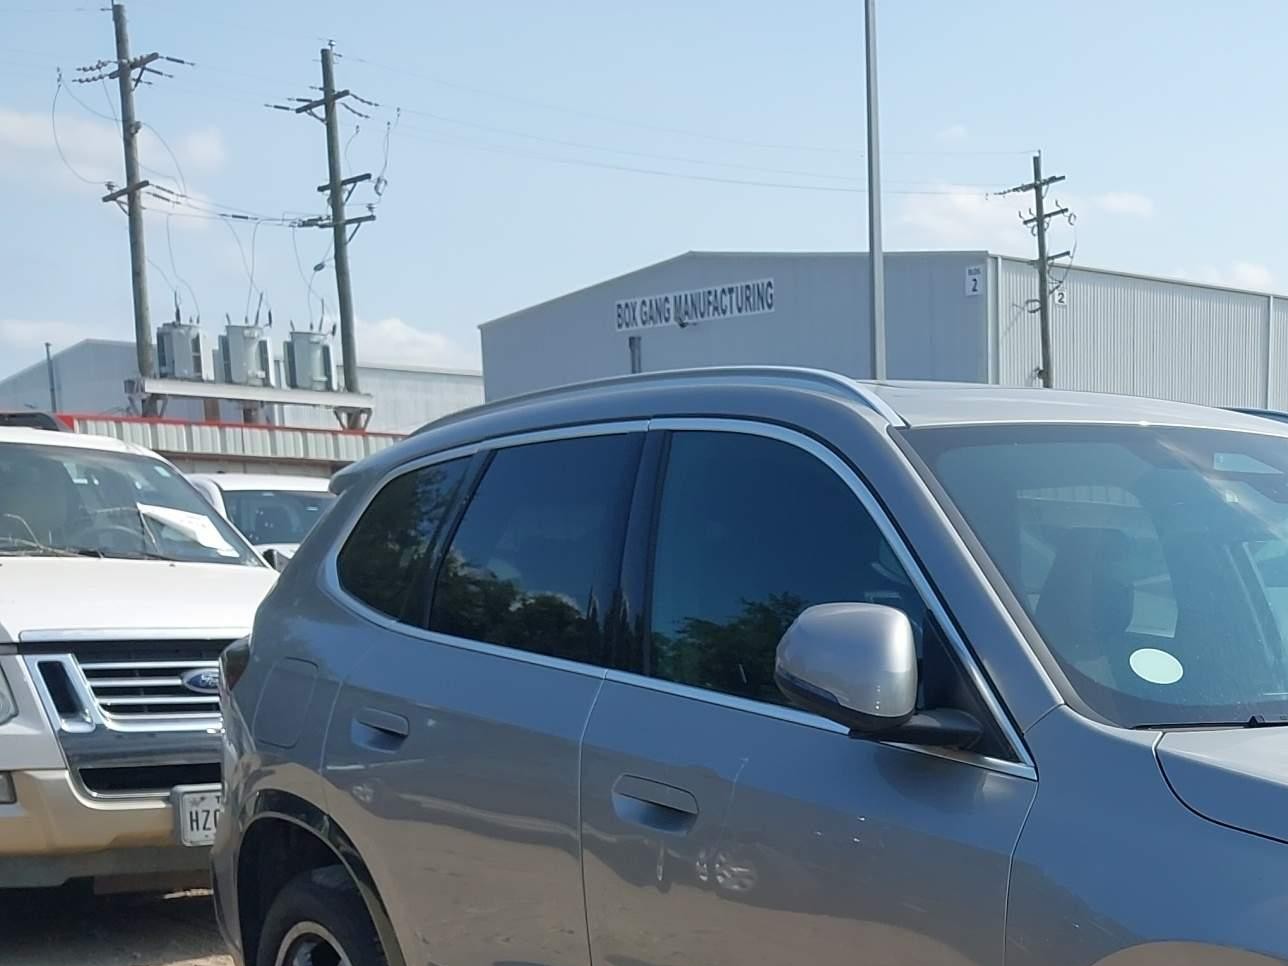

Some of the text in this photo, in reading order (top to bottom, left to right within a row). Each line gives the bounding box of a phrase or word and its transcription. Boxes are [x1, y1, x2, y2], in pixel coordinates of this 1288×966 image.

[971, 278, 978, 292] 2
[616, 280, 774, 329] BOX GANG MANUFACTURING
[1058, 292, 1065, 304] 2
